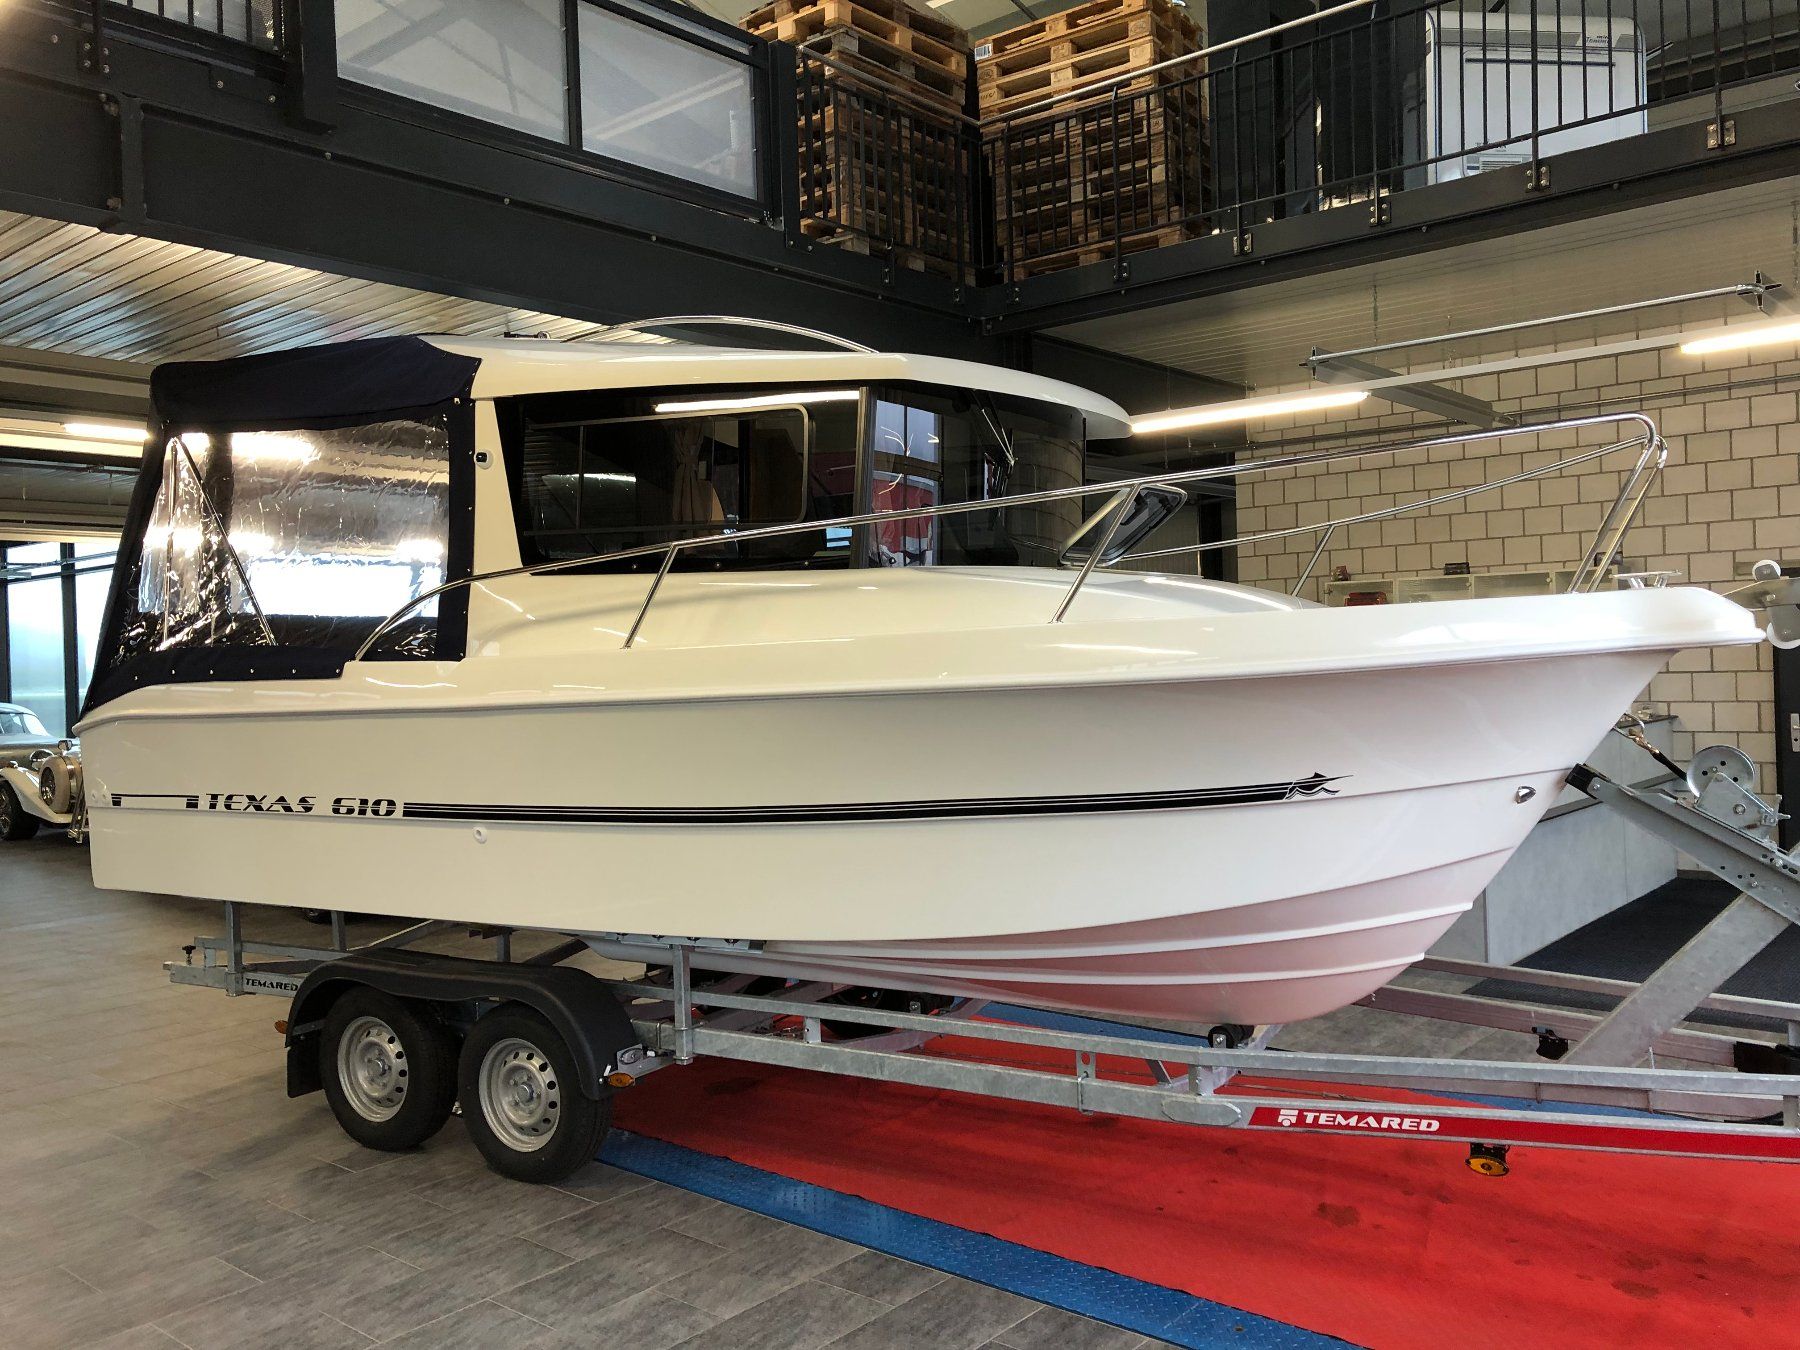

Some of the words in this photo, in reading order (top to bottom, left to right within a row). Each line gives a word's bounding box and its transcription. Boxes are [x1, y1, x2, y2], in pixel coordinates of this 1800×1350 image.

[205, 793, 317, 814] TEXAS
[330, 797, 397, 817] 610
[245, 977, 299, 992] TEMARED
[1303, 1111, 1440, 1132] TEMARED
